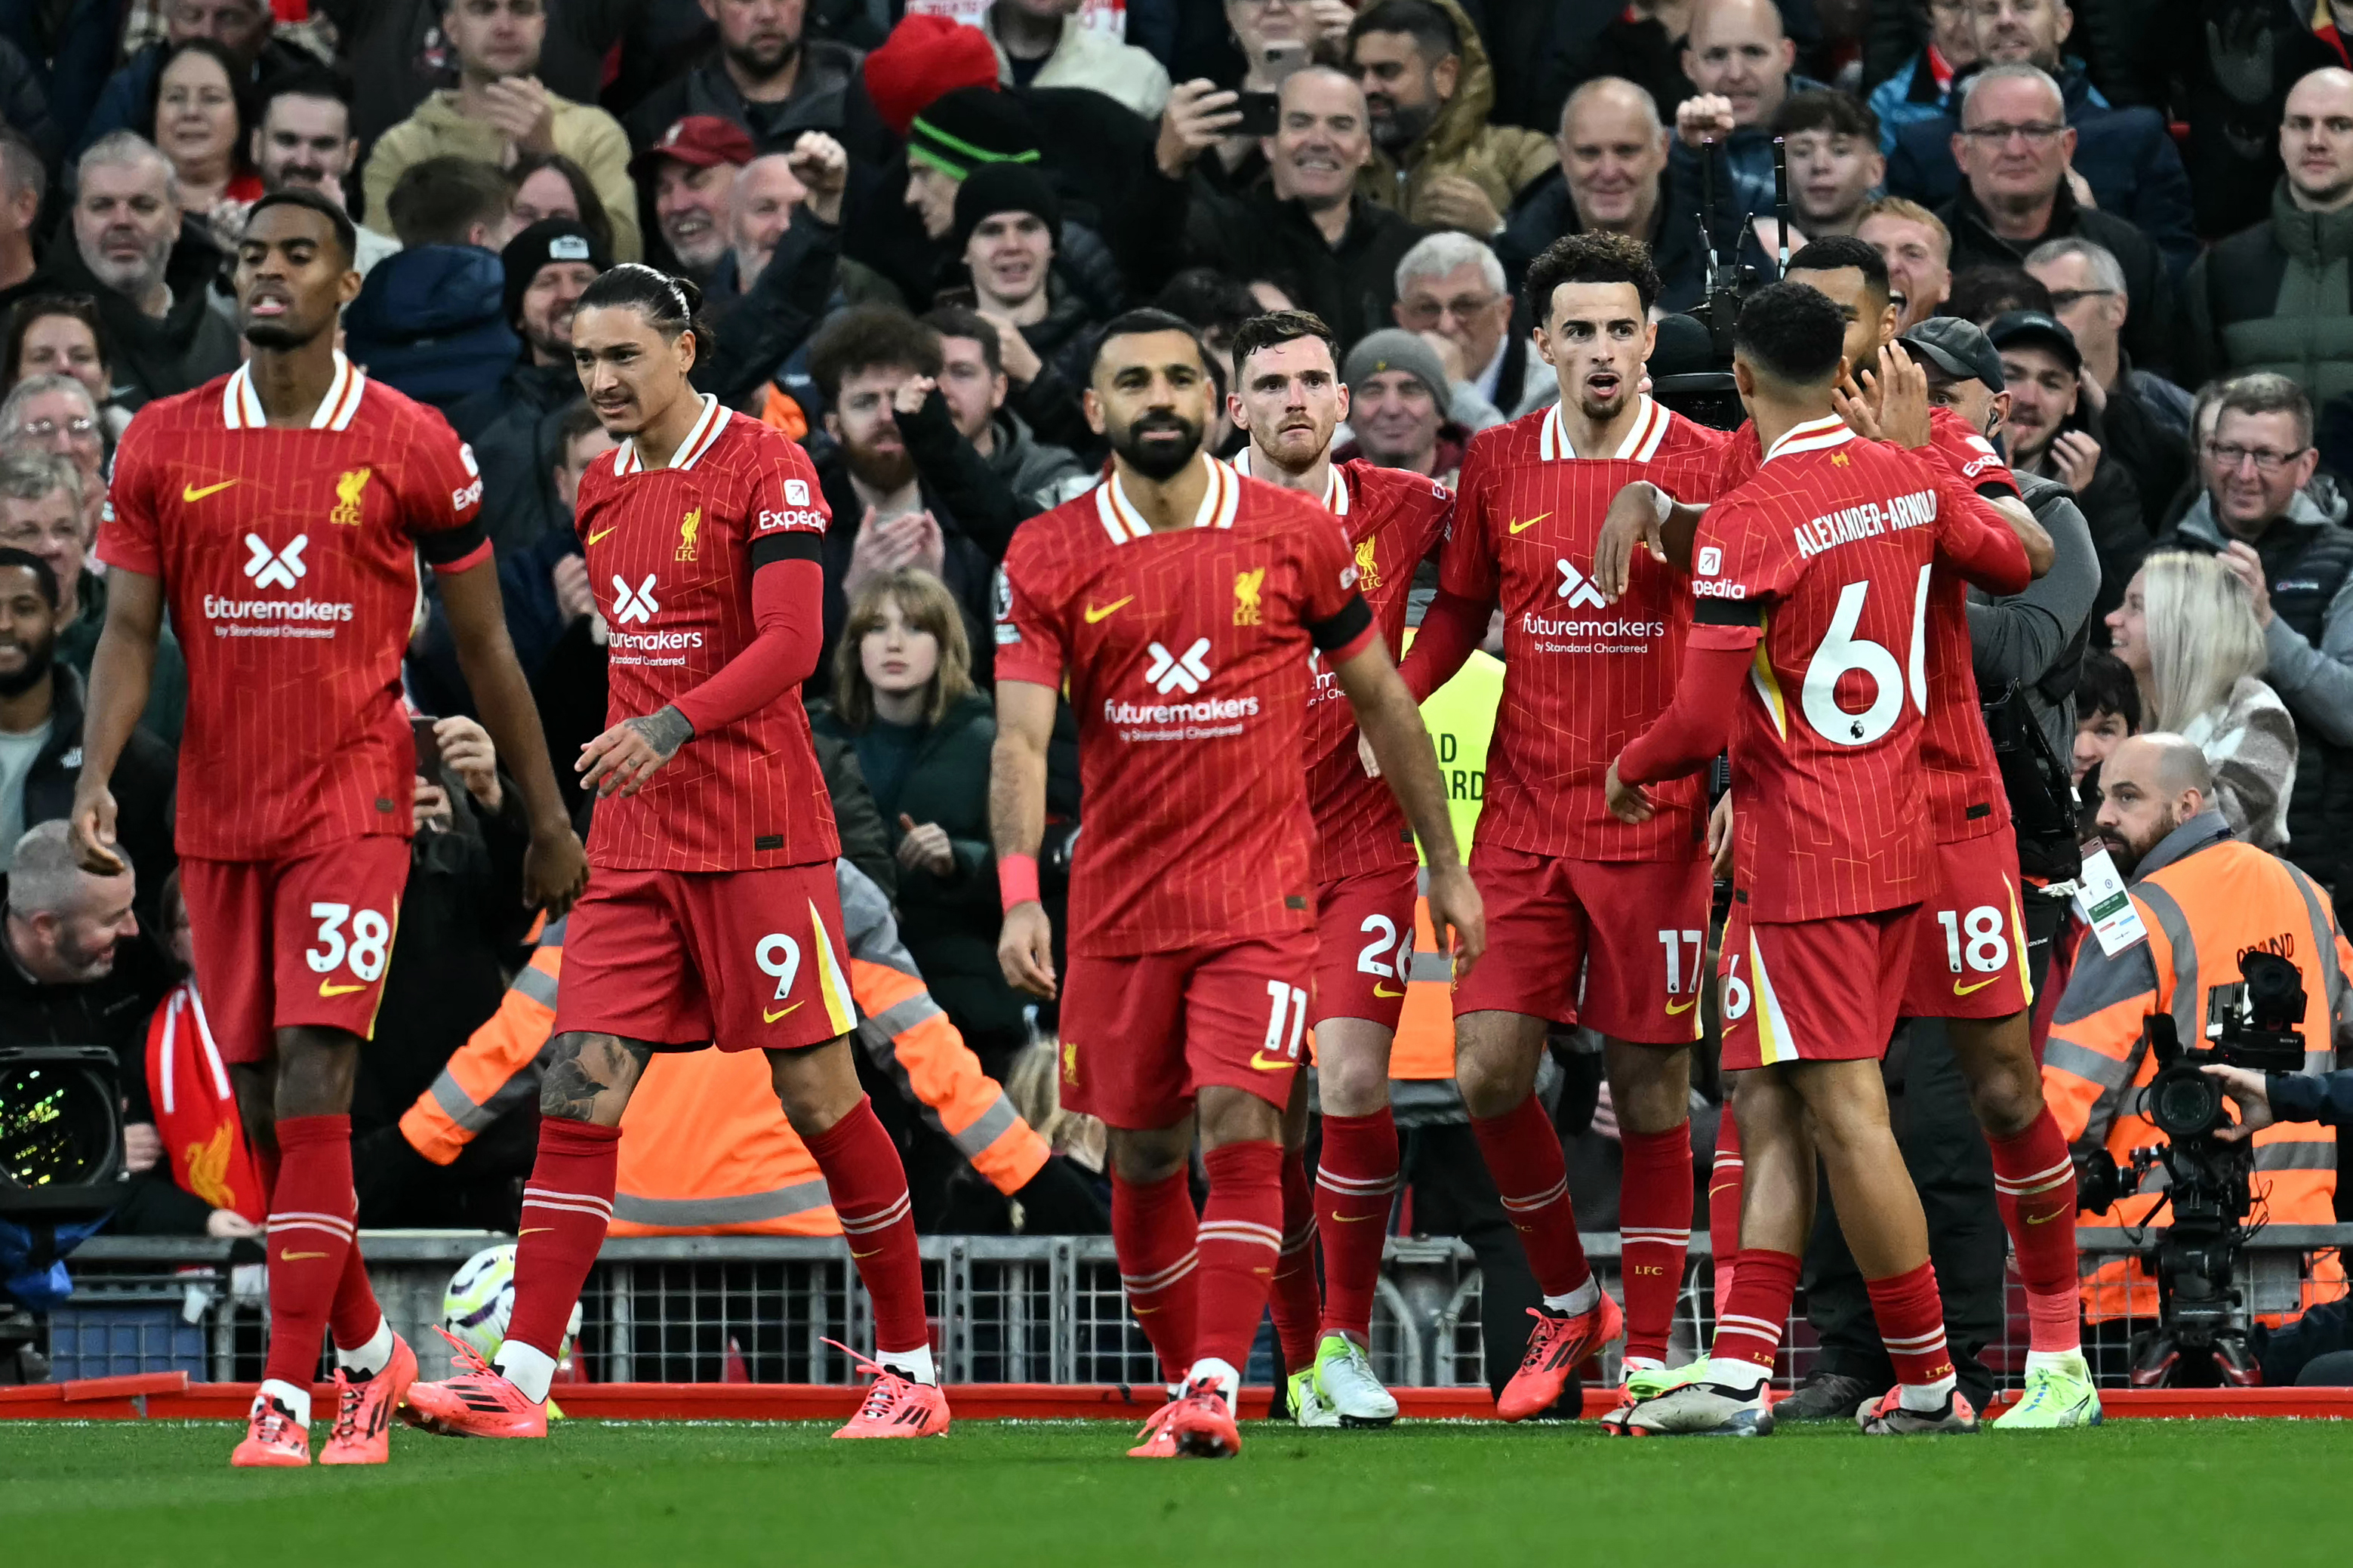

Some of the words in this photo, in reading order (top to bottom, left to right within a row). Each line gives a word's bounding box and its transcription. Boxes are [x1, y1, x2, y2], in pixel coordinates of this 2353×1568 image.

[759, 510, 826, 533] Expedia
[1794, 489, 1938, 559] ALEXANDER-ARNOLD
[204, 594, 354, 622] futuremakers
[1523, 612, 1665, 637] futuremakers
[642, 655, 685, 667] Cartered
[1535, 640, 1544, 654] by
[1545, 642, 1591, 654] Standard
[1594, 642, 1649, 654] Chartered
[1104, 696, 1259, 724] futuremakers
[1448, 769, 1485, 801] RD
[306, 901, 390, 982] 38
[1937, 905, 2010, 973] 18
[755, 933, 801, 1000] 9
[1658, 929, 1703, 994] 17
[1723, 953, 1751, 1019] 6
[1264, 979, 1308, 1059] 11
[1635, 1265, 1664, 1276] LFC
[1926, 1362, 1954, 1379] LFC
